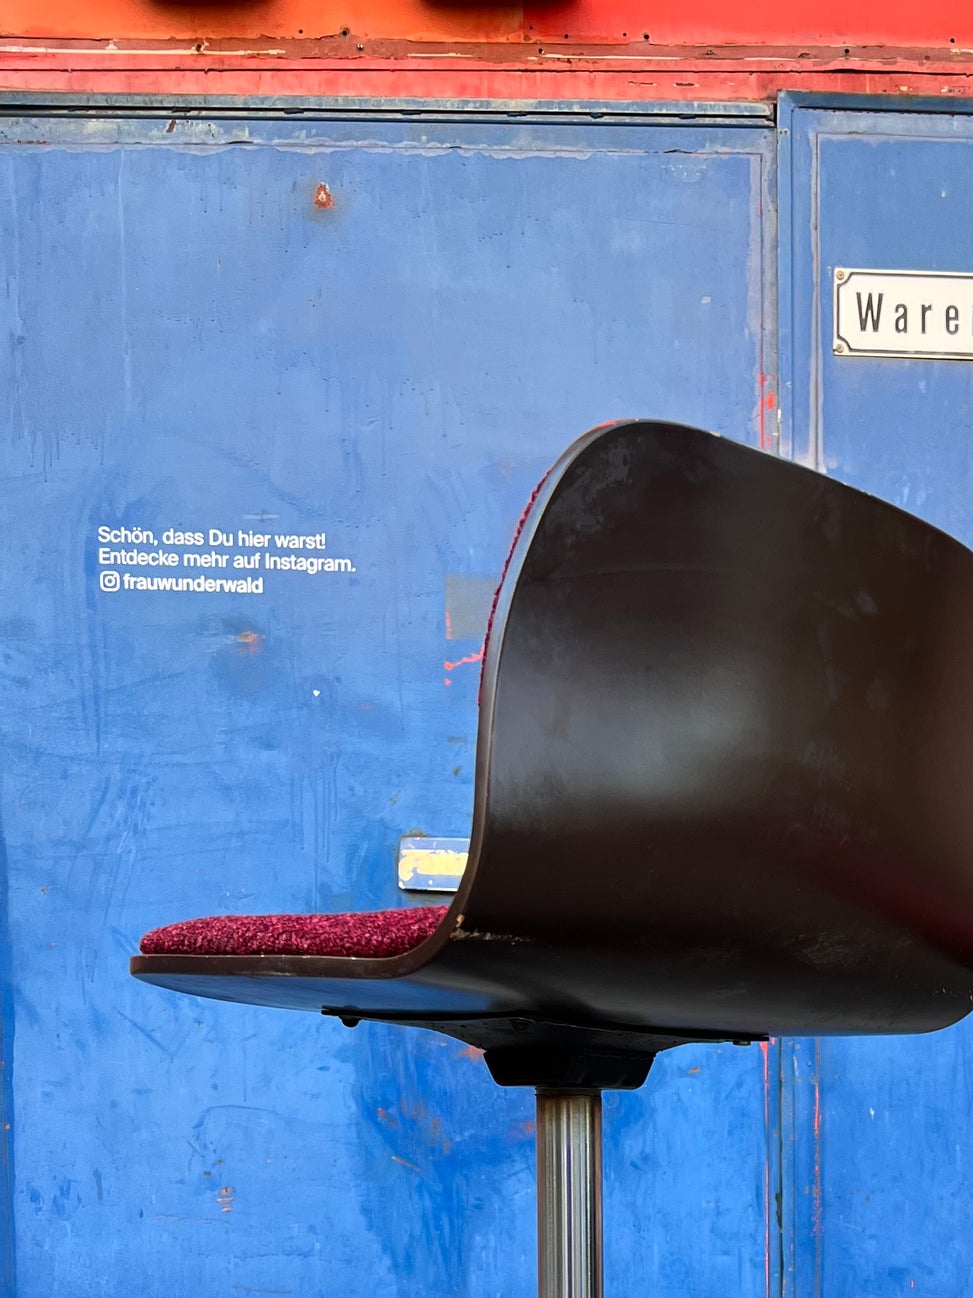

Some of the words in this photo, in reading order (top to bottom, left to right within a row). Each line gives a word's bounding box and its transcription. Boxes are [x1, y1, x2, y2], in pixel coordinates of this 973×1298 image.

[98, 526, 159, 546] Schön,
[162, 528, 205, 546] dass
[208, 529, 234, 548] Du
[237, 530, 271, 549] hier
[274, 532, 326, 550] warst!
[98, 548, 180, 566] Entdecke
[183, 552, 229, 568] mehr
[232, 552, 261, 569] auf
[265, 552, 356, 574] Instagram.
[123, 573, 264, 594] frauwunderwald
